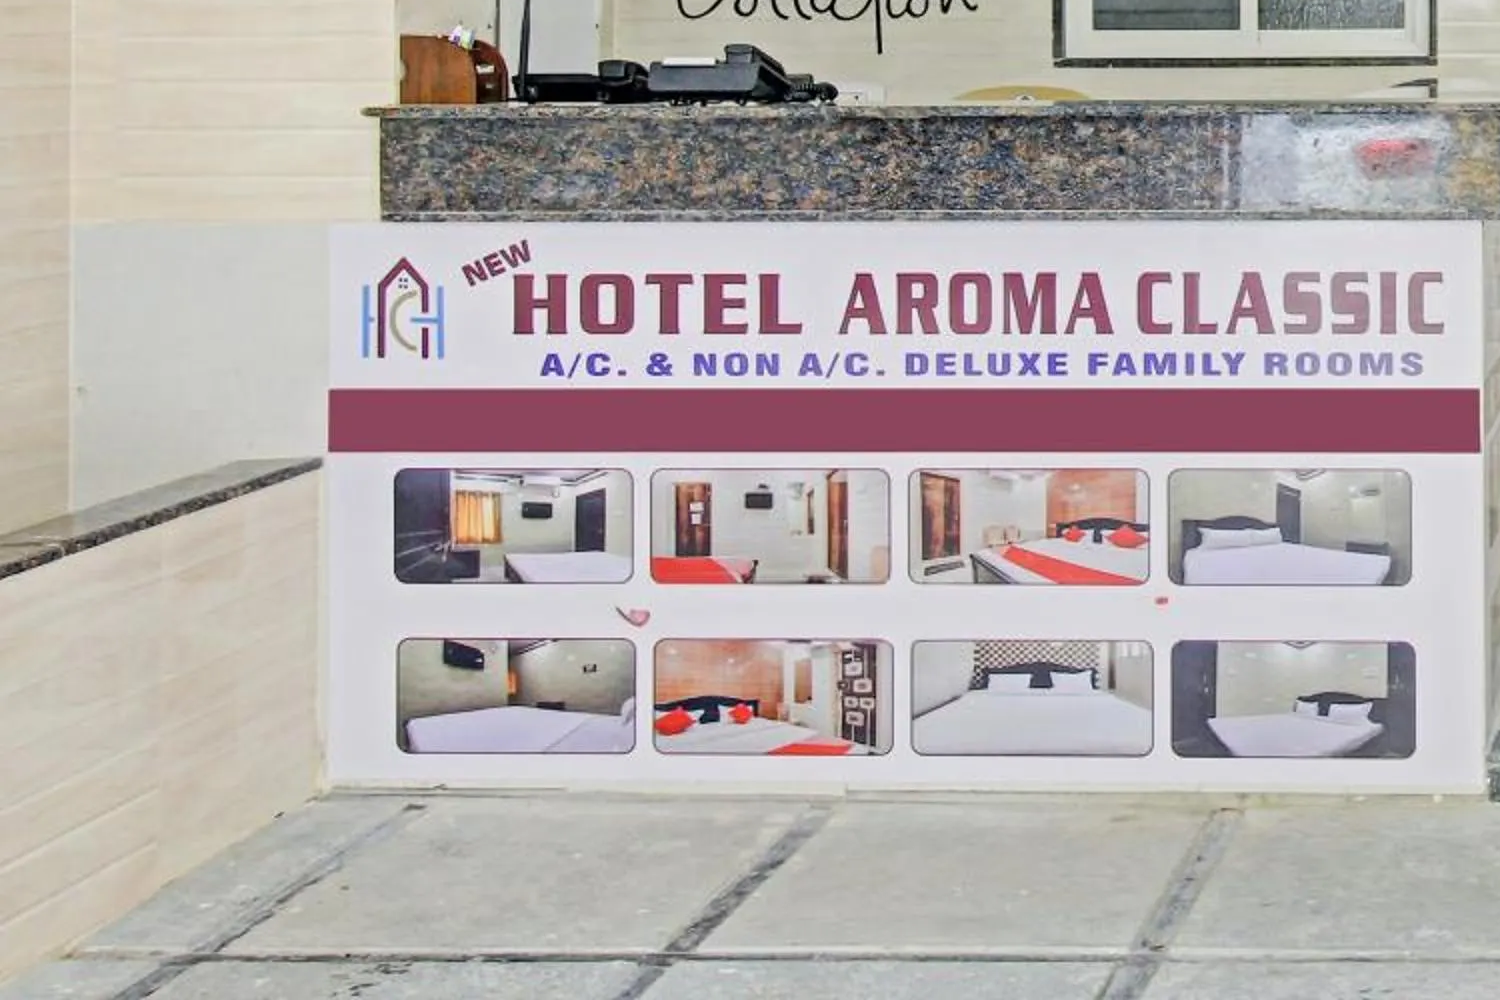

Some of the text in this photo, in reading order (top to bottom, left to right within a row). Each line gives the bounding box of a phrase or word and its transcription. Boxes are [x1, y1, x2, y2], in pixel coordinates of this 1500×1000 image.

[461, 238, 533, 287] NEW
[512, 271, 1445, 336] HOTEL AROMA CLASSIC
[540, 351, 1425, 379] A/C. & NON A/C. DELUXE FAMILY ROOMS
